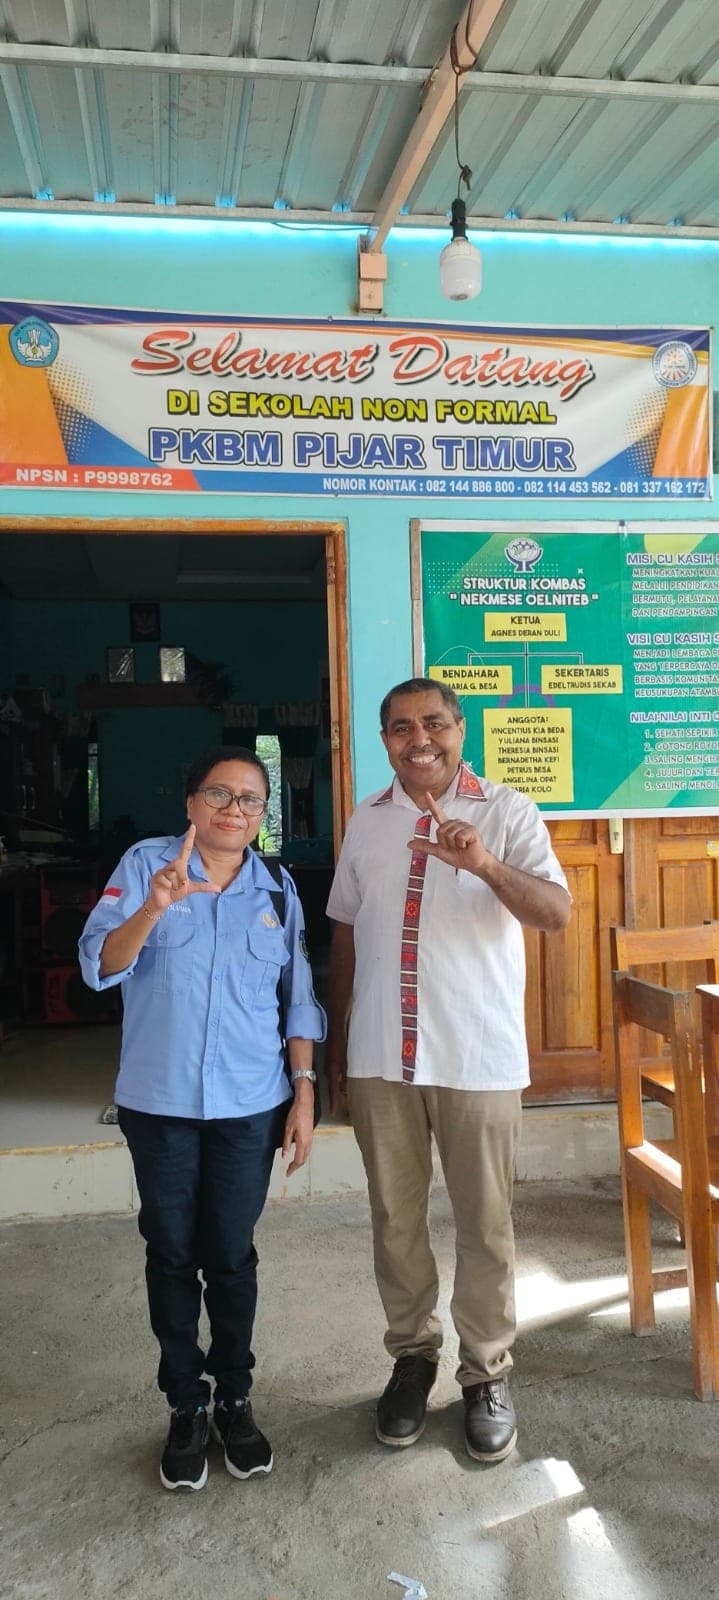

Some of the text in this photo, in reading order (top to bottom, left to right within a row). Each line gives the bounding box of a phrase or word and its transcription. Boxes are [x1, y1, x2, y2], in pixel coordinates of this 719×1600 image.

[131, 330, 377, 382] Selamat
[389, 334, 595, 401] Datang
[168, 389, 557, 424] DI SEKOLAH NON FORMAL
[148, 428, 576, 471] PKBM PIJAR TIMUR
[16, 468, 68, 484] NPSN
[84, 470, 173, 486] P9998762
[323, 478, 366, 490] NOMOR
[369, 479, 416, 492] KONTAK
[426, 480, 446, 492] 082
[449, 480, 469, 492] 144
[472, 481, 492, 493] 886
[495, 481, 515, 493] 800
[524, 481, 544, 493] 082
[547, 481, 566, 493] 114
[569, 481, 589, 493] 453
[591, 482, 611, 493] 562
[620, 482, 639, 493] 081
[642, 482, 662, 493] 337
[665, 482, 683, 493] 162
[685, 482, 705, 493] 172
[627, 553, 653, 565] MISI
[656, 553, 673, 565] CU
[677, 553, 714, 565] KASIH
[463, 577, 586, 590] STRUKTUR KOMBAS
[460, 593, 522, 605] NEKMESE
[525, 594, 589, 606] OELNITEB
[510, 616, 541, 625] KETUA
[627, 633, 651, 645] VISI
[653, 633, 671, 645] CU
[674, 633, 711, 645] KASIH
[442, 669, 499, 678] BENDAHARA
[555, 668, 610, 678] SEKERTARIS
[479, 682, 498, 690] BESA
[548, 681, 591, 689] EDELTRUDIS
[689, 711, 711, 722] INTI
[490, 727, 532, 735] VINCENTIUS
[498, 746, 531, 754] THERESIA
